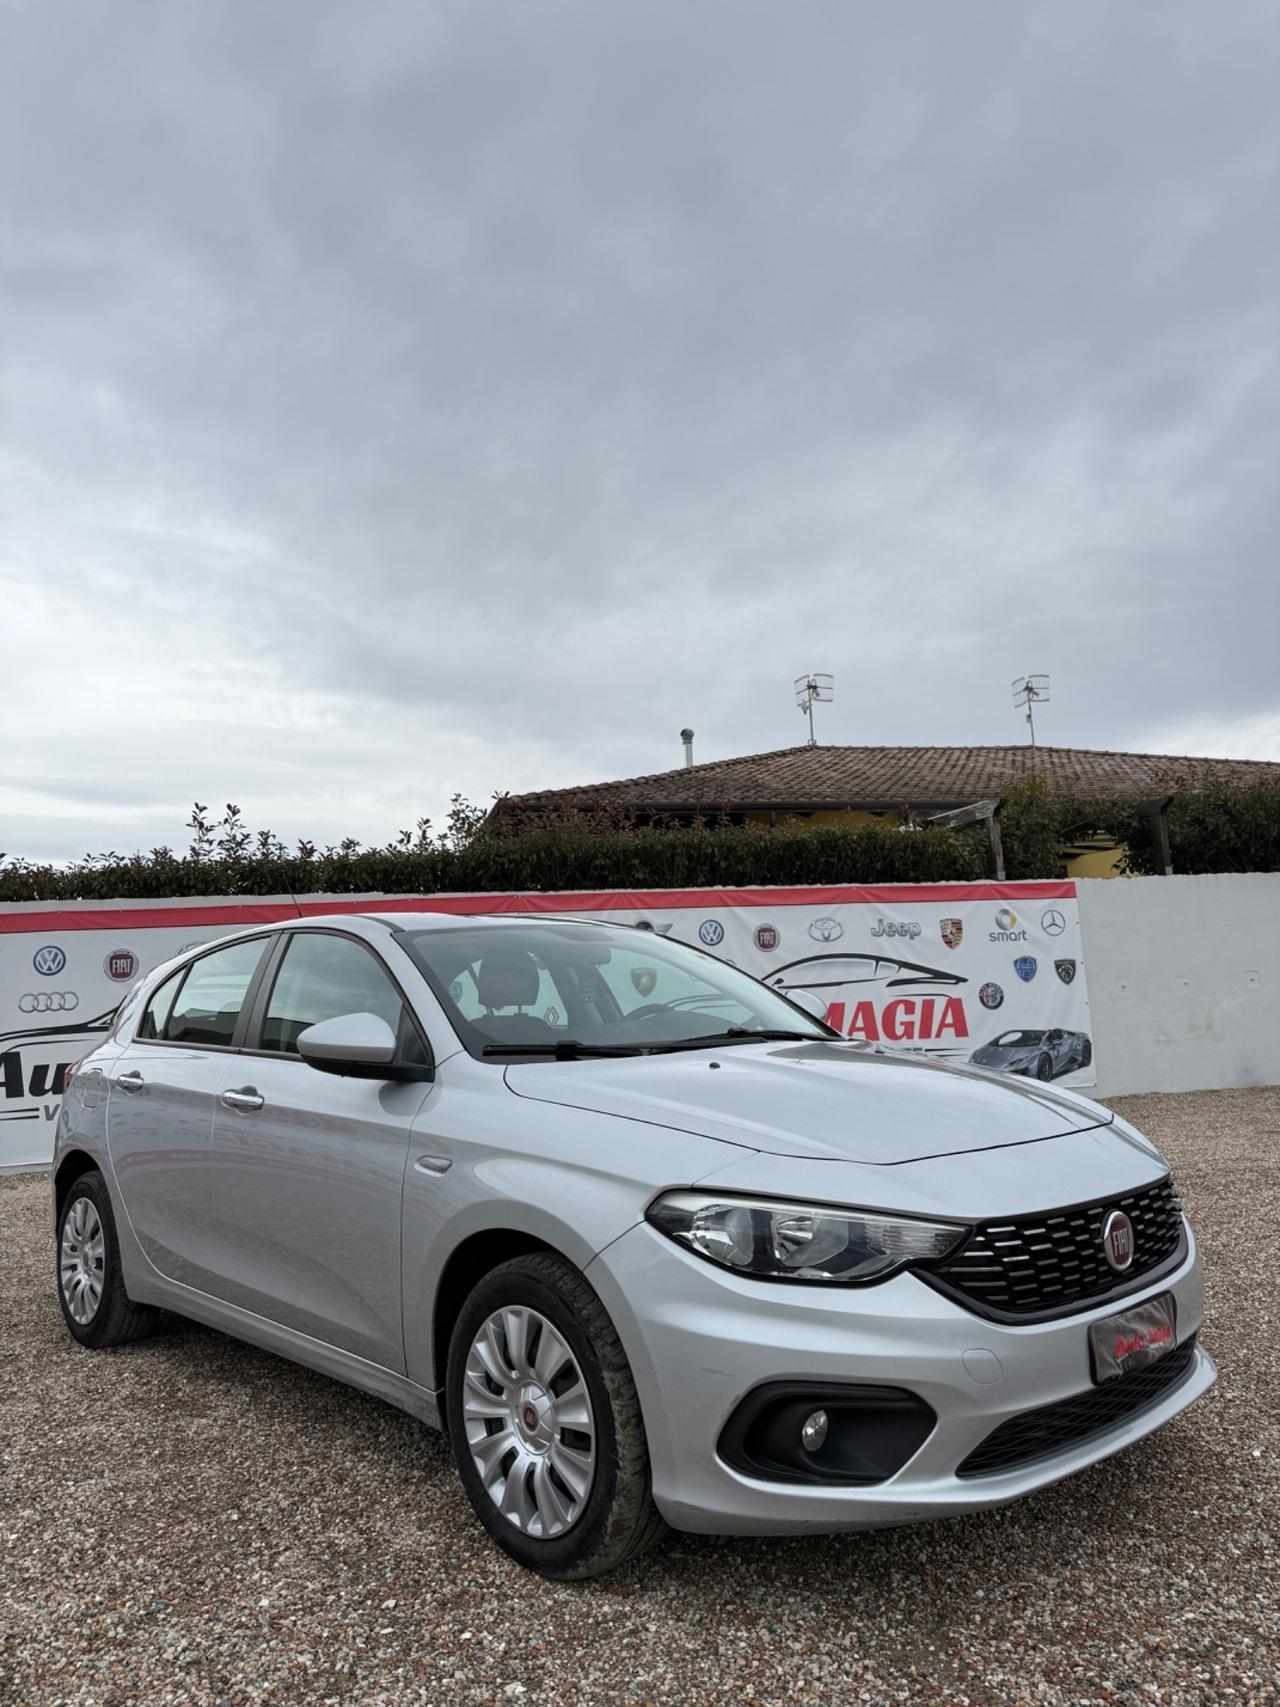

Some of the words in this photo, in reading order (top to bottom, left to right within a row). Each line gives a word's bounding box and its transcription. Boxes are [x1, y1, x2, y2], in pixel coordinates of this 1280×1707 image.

[871, 918, 922, 940] Jeep
[989, 930, 1028, 942] smart
[759, 931, 775, 945] FIAT
[112, 958, 133, 974] FIAT
[1112, 1227, 1130, 1257] FIAT
